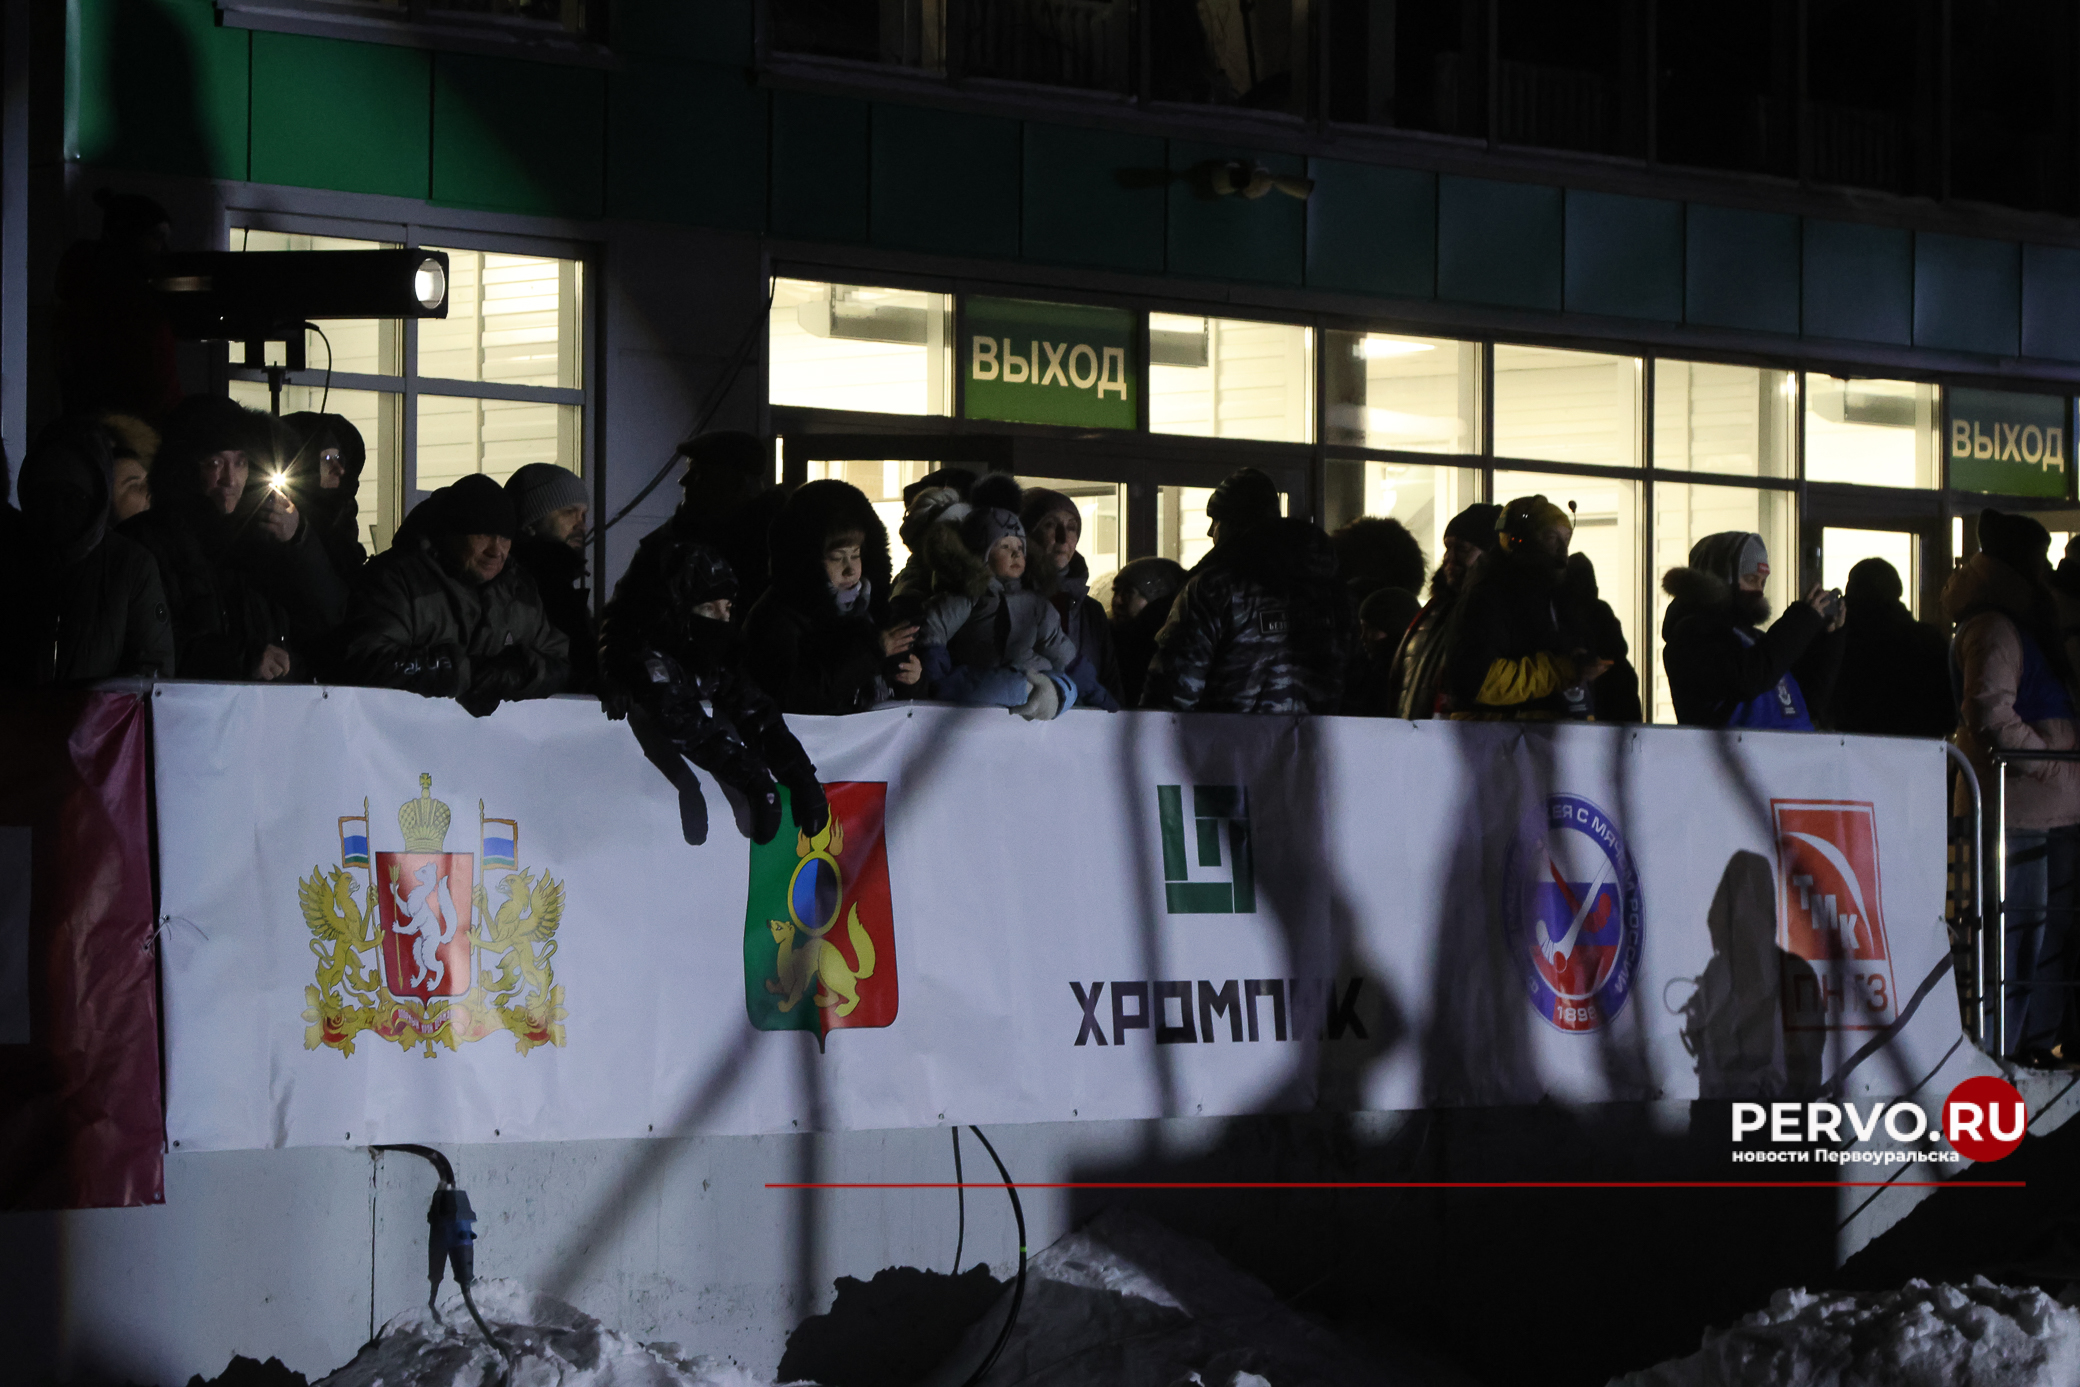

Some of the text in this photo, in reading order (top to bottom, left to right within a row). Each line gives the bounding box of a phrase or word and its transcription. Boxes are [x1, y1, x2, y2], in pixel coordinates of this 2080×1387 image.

[972, 335, 1127, 401] ВЫХОД
[1952, 419, 2065, 474] ВЫХОД
[1792, 874, 1860, 950] ТМК
[1069, 977, 1370, 1046] ХРОМПИК
